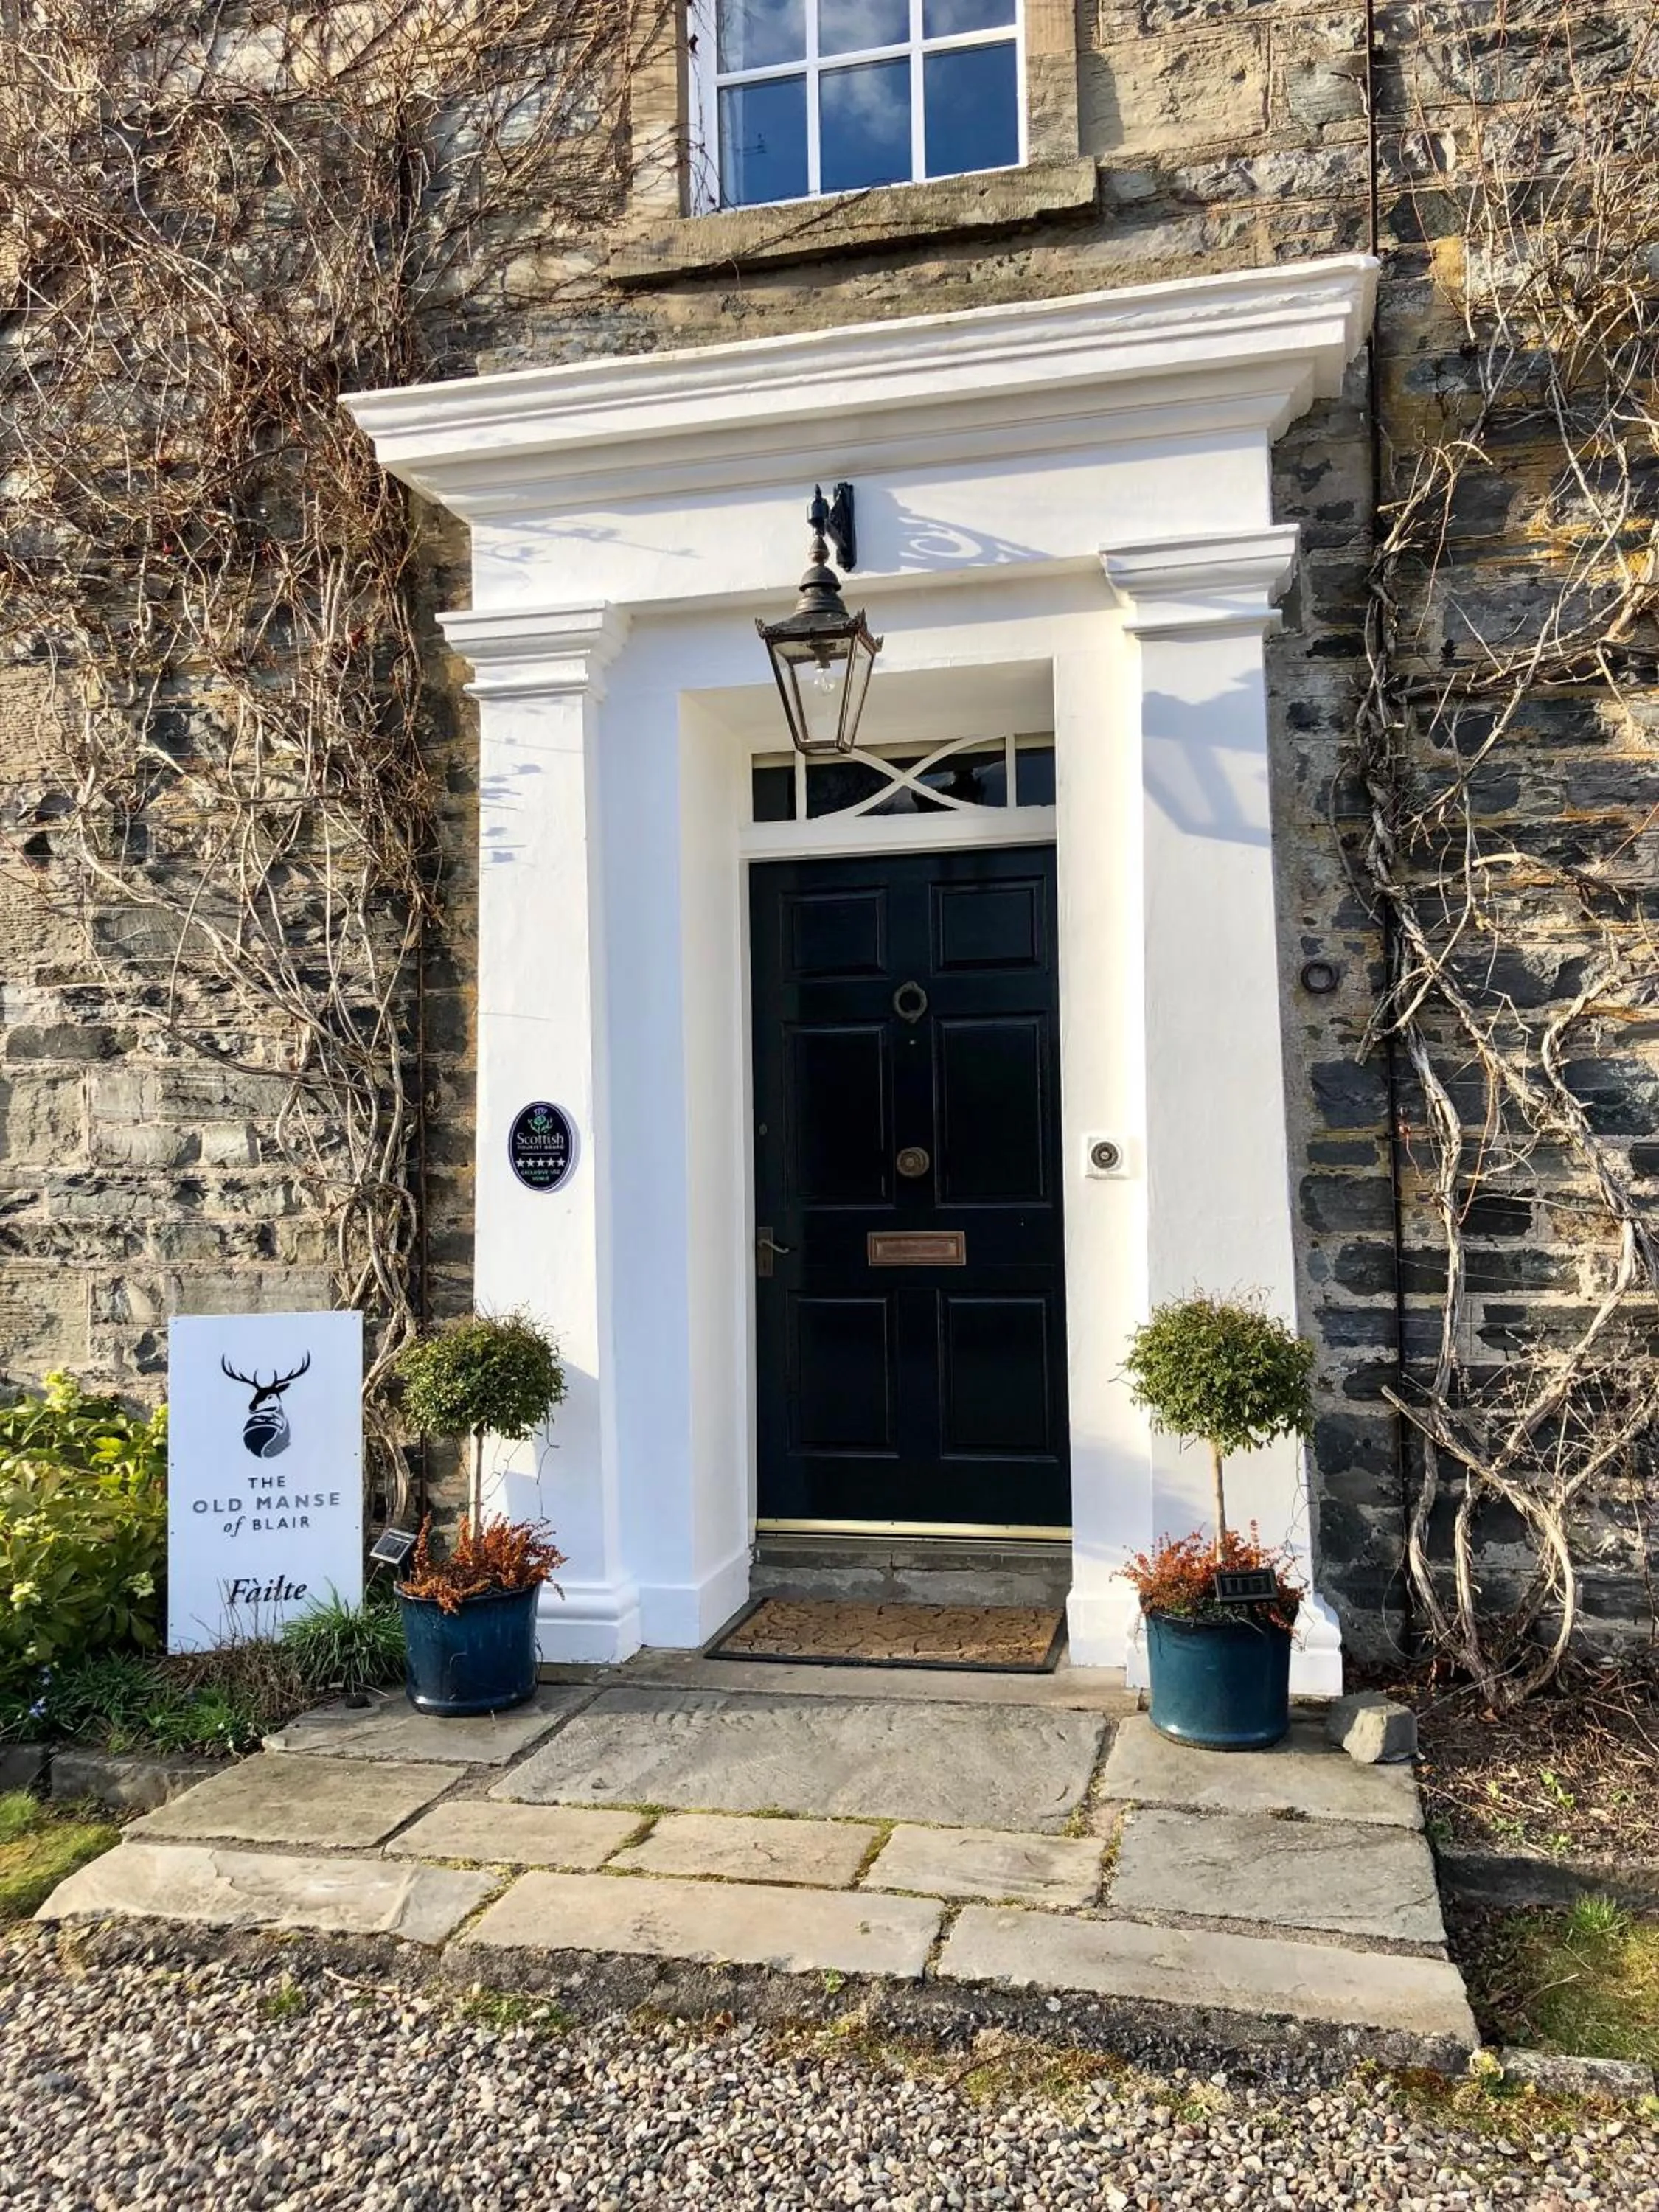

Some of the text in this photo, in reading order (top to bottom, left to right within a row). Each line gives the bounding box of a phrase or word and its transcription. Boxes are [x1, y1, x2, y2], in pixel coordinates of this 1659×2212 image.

[516, 1132, 564, 1145] Scottish
[248, 1475, 286, 1489] THE
[192, 1492, 341, 1514] OLD MANSE
[223, 1515, 310, 1537] of BLAIR
[226, 1574, 307, 1604] Fàilte
